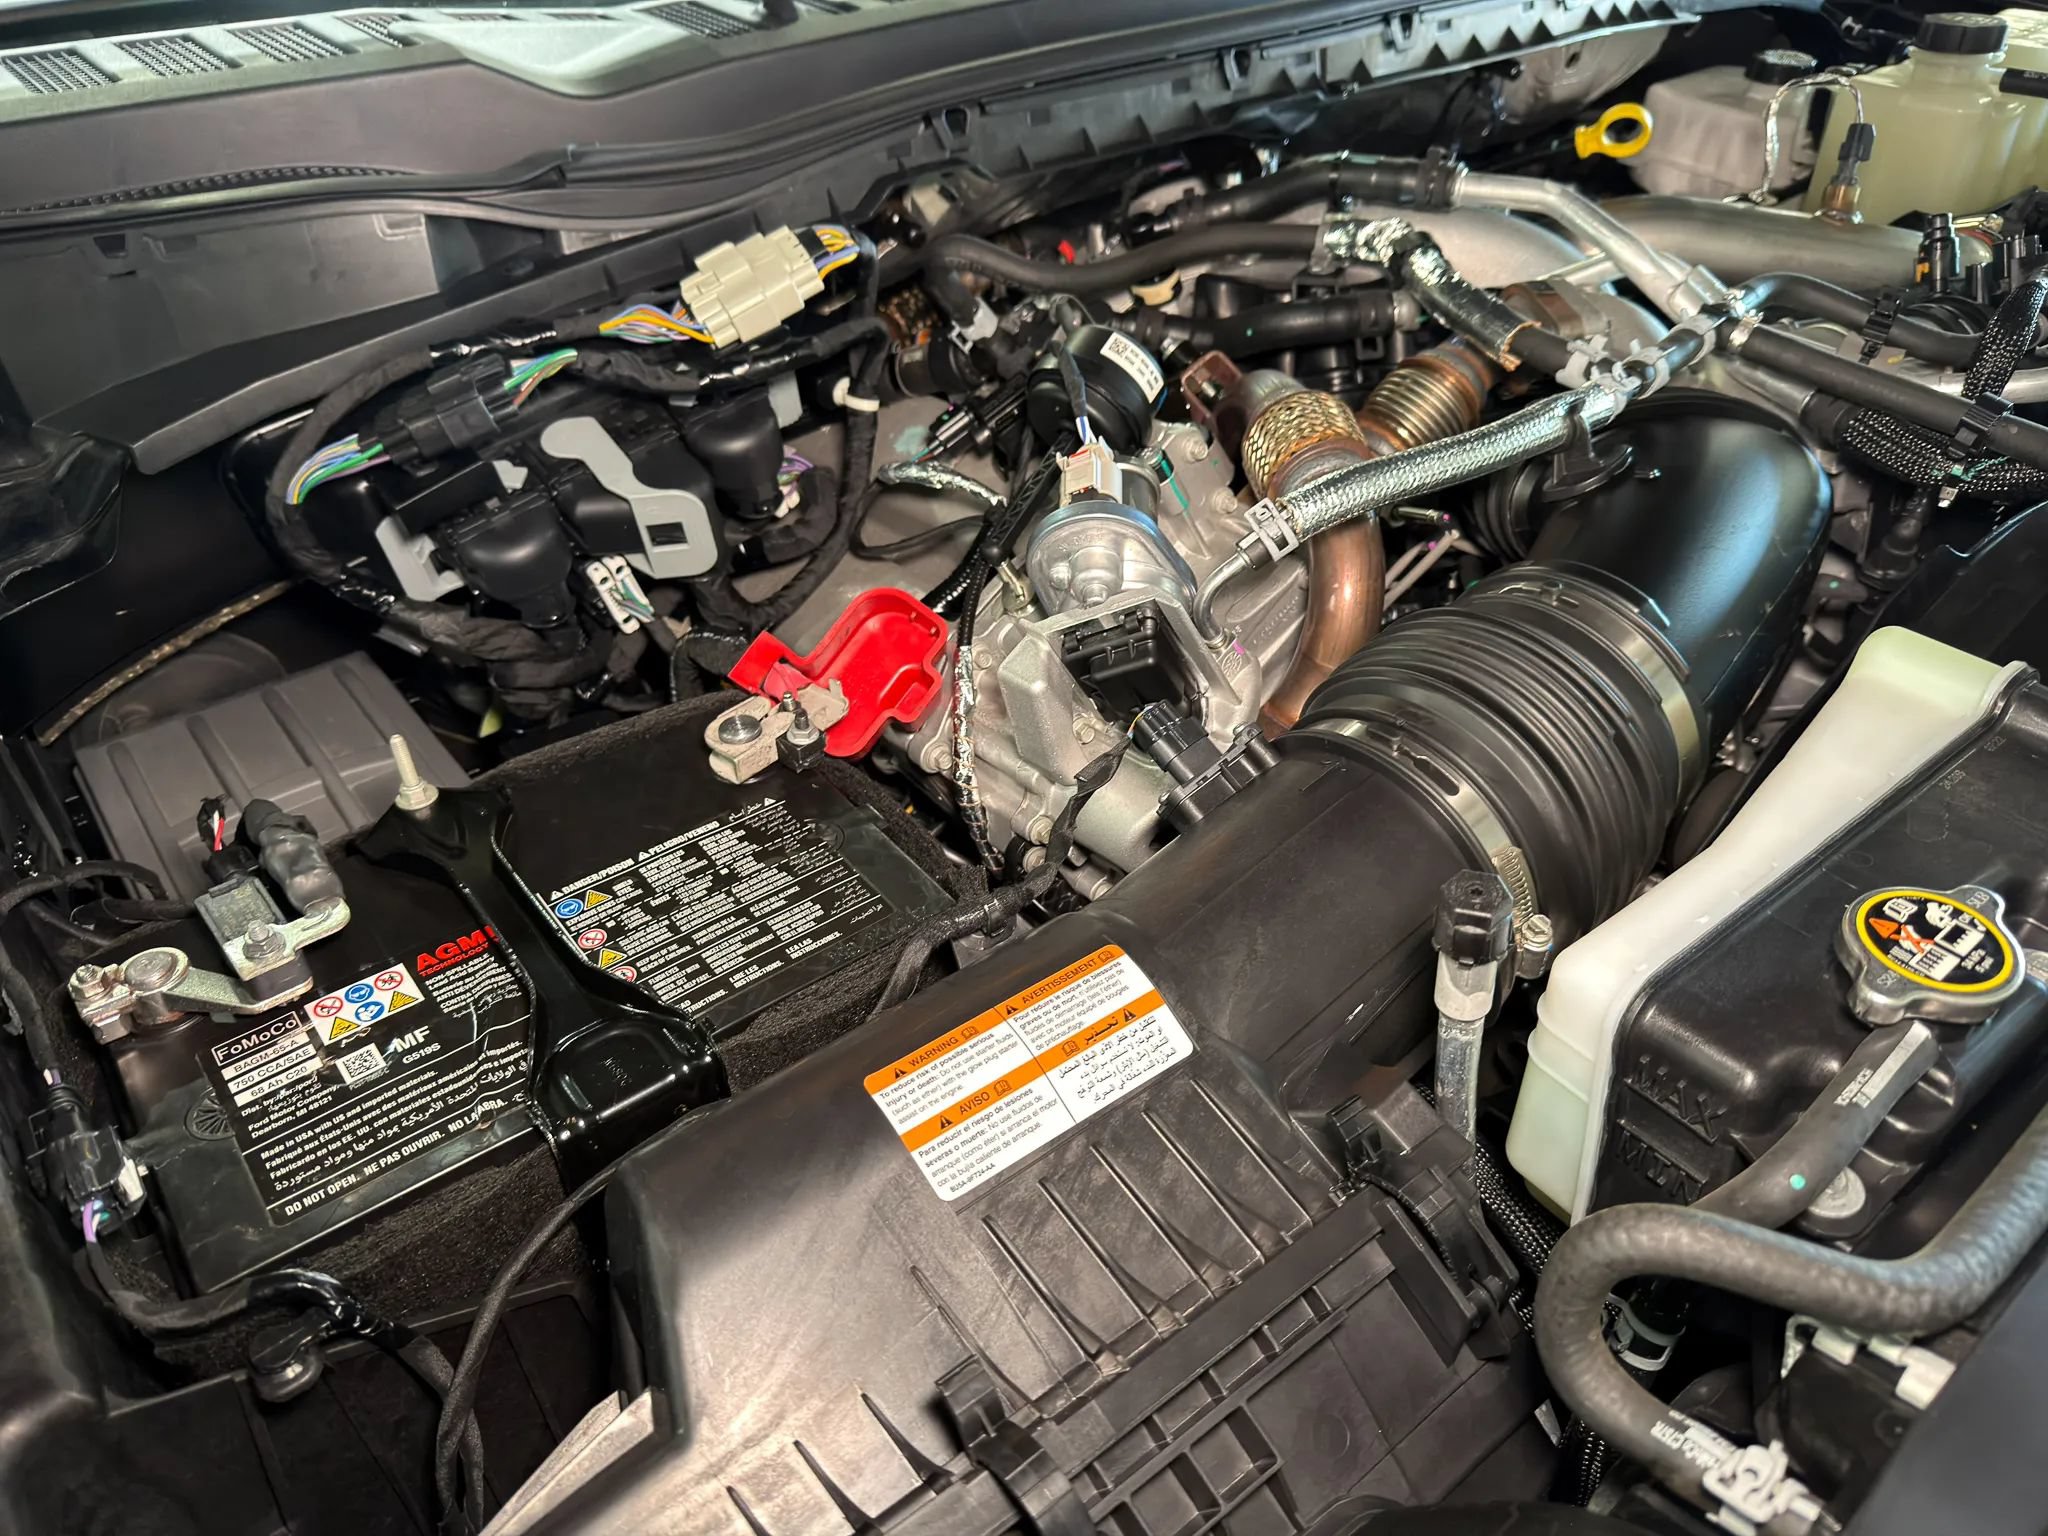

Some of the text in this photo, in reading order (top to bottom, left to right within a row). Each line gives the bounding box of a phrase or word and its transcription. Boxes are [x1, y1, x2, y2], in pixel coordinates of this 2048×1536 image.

[562, 858, 634, 893] DANGER/POISON
[419, 942, 488, 977] TECHNOLOGY
[425, 953, 489, 985] NON-SPILLABLE
[428, 956, 494, 990] Lead Acid Battery
[1012, 1011, 1029, 1022] Pour
[1030, 998, 1054, 1013] réduire
[1061, 983, 1081, 996] risque
[1090, 961, 1121, 979] blessures
[1022, 958, 1096, 1003] AVERTISSEMENT
[1019, 1014, 1042, 1030] graves
[1042, 1008, 1051, 1016] ou
[1051, 1003, 1060, 1011] de
[217, 1015, 296, 1060] FoMoCo
[393, 1025, 429, 1052] MF
[402, 1042, 440, 1063] G519S
[908, 1036, 958, 1066] WARNING
[233, 1039, 298, 1072] BAGM-65-A
[233, 1048, 310, 1088] 750 CCA/SAE
[890, 1077, 915, 1093] reduce
[915, 1069, 930, 1079] risk
[938, 1047, 968, 1067] possible
[968, 1033, 994, 1049] serious
[250, 1066, 307, 1096] 68 Ah C20
[916, 1074, 939, 1089] death:
[938, 1068, 950, 1076] Do
[950, 1061, 962, 1070] not
[241, 1104, 262, 1116] Dist.
[260, 1070, 437, 1159] Made in USA with US and imported materials.
[295, 1107, 307, 1116] MI
[308, 1095, 332, 1110] 48121
[959, 1091, 990, 1115] AVISO
[1634, 1056, 1728, 1144] MAX
[247, 1105, 295, 1131] Ford Motor
[265, 1146, 302, 1169] Fabriqué
[303, 1139, 319, 1150] aux
[319, 1118, 361, 1142] États-Unis
[362, 1108, 381, 1121] avec
[381, 1100, 397, 1111] des
[397, 1081, 436, 1103] matériaux
[316, 1147, 327, 1156] en
[327, 1140, 341, 1150] los
[341, 1133, 356, 1143] EE.
[356, 1125, 372, 1136] UU.
[373, 1116, 388, 1127] con
[388, 1095, 431, 1119] materiales
[918, 1088, 1032, 1158] Para reducir el riesgo de lesiones
[925, 1148, 953, 1167] severas
[960, 1128, 987, 1147] muerte:
[987, 1121, 998, 1130] No
[999, 1113, 1012, 1123] use
[1033, 1095, 1042, 1103] de
[284, 1201, 302, 1215] DO
[302, 1188, 324, 1206] NOT
[327, 1174, 360, 1194] OPEN.
[363, 1161, 379, 1175] NE
[378, 1151, 400, 1167] PAS
[401, 1130, 444, 1155] OUVRIR.
[447, 1119, 464, 1132] NO
[477, 1097, 508, 1117] ABRA.
[324, 1149, 352, 1167] ومواد
[352, 1138, 374, 1151] منها
[274, 1165, 320, 1190] مستوردة
[1616, 1130, 1703, 1206] MIN
